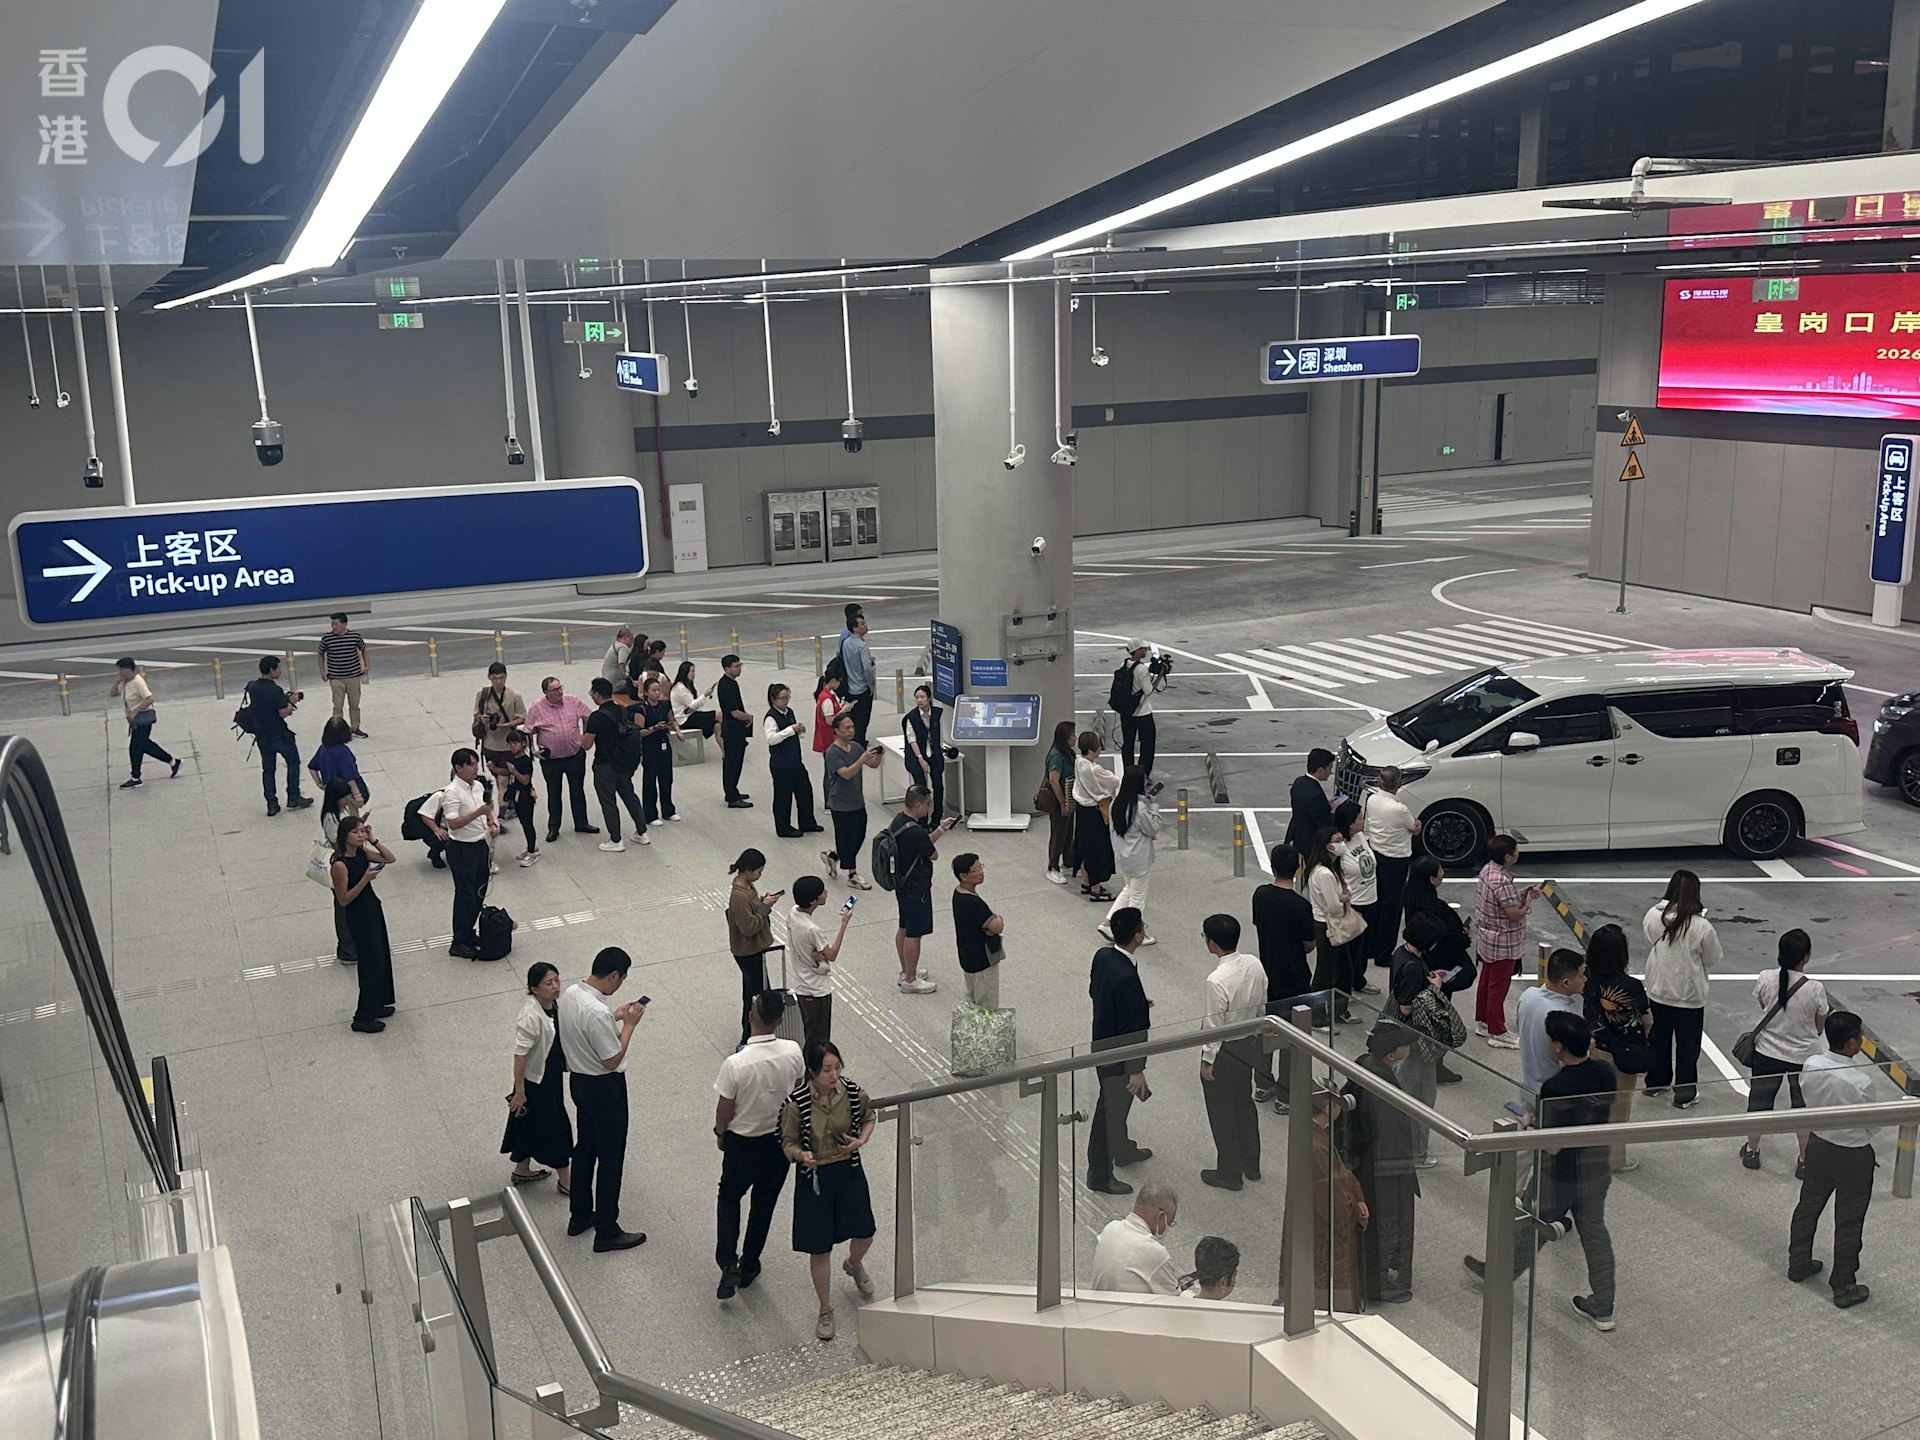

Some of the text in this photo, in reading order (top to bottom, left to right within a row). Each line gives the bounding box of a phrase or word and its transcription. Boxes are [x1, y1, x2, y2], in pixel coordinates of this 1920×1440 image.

[1754, 311, 1920, 334] 皇岗口岸
[1301, 351, 1317, 371] 深
[1324, 347, 1347, 361] 深圳
[1323, 362, 1363, 373] Shenzhen
[1890, 476, 1906, 522] 上客区
[1879, 512, 1889, 536] Area
[126, 528, 242, 569] 上客区
[128, 566, 295, 598] Pick-up Area
